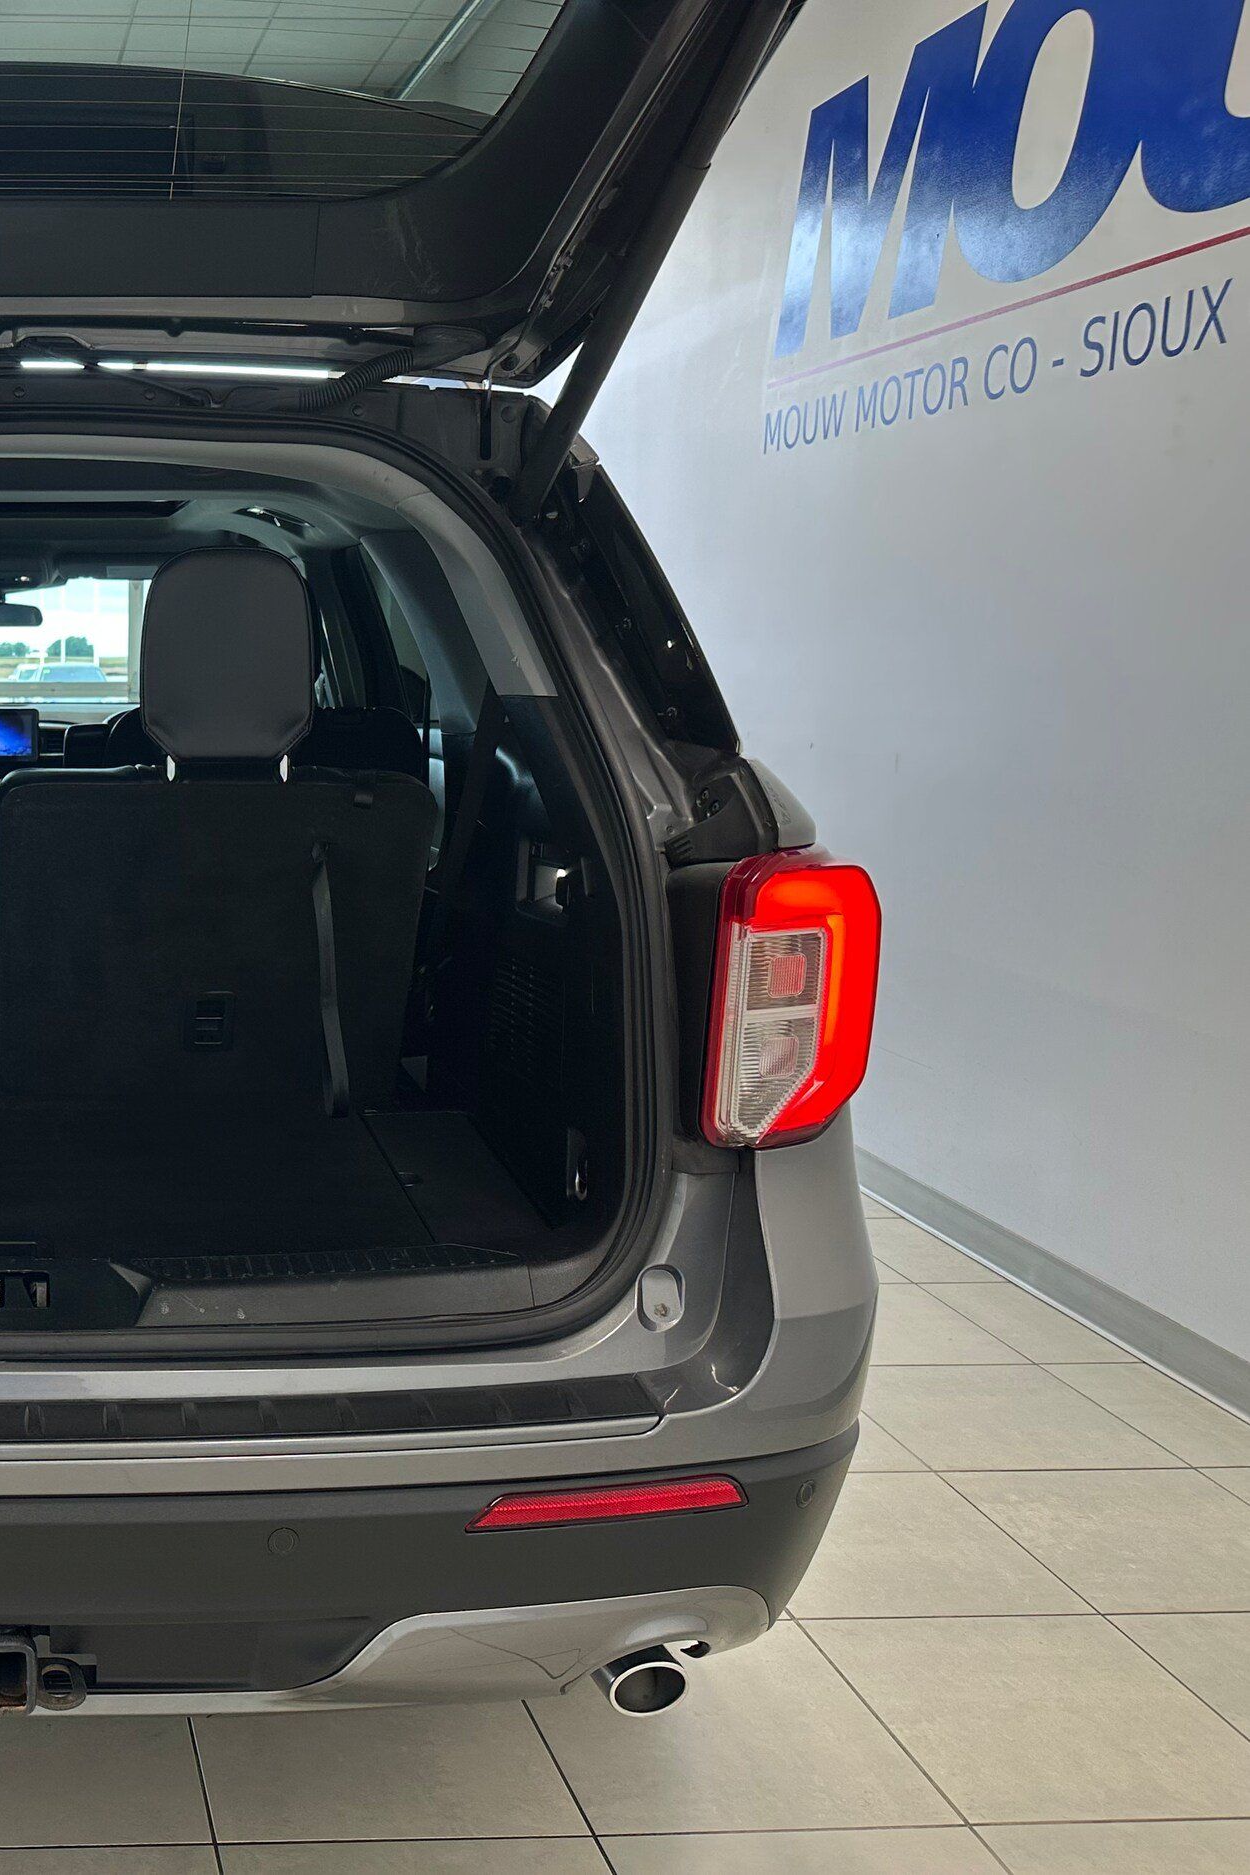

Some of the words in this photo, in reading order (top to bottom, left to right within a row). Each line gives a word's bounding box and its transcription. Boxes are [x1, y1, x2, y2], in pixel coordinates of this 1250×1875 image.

[763, 391, 848, 455] MOUW
[854, 356, 970, 433] MOTOR
[983, 337, 1038, 401] CO
[1079, 278, 1234, 378] SIOUX
